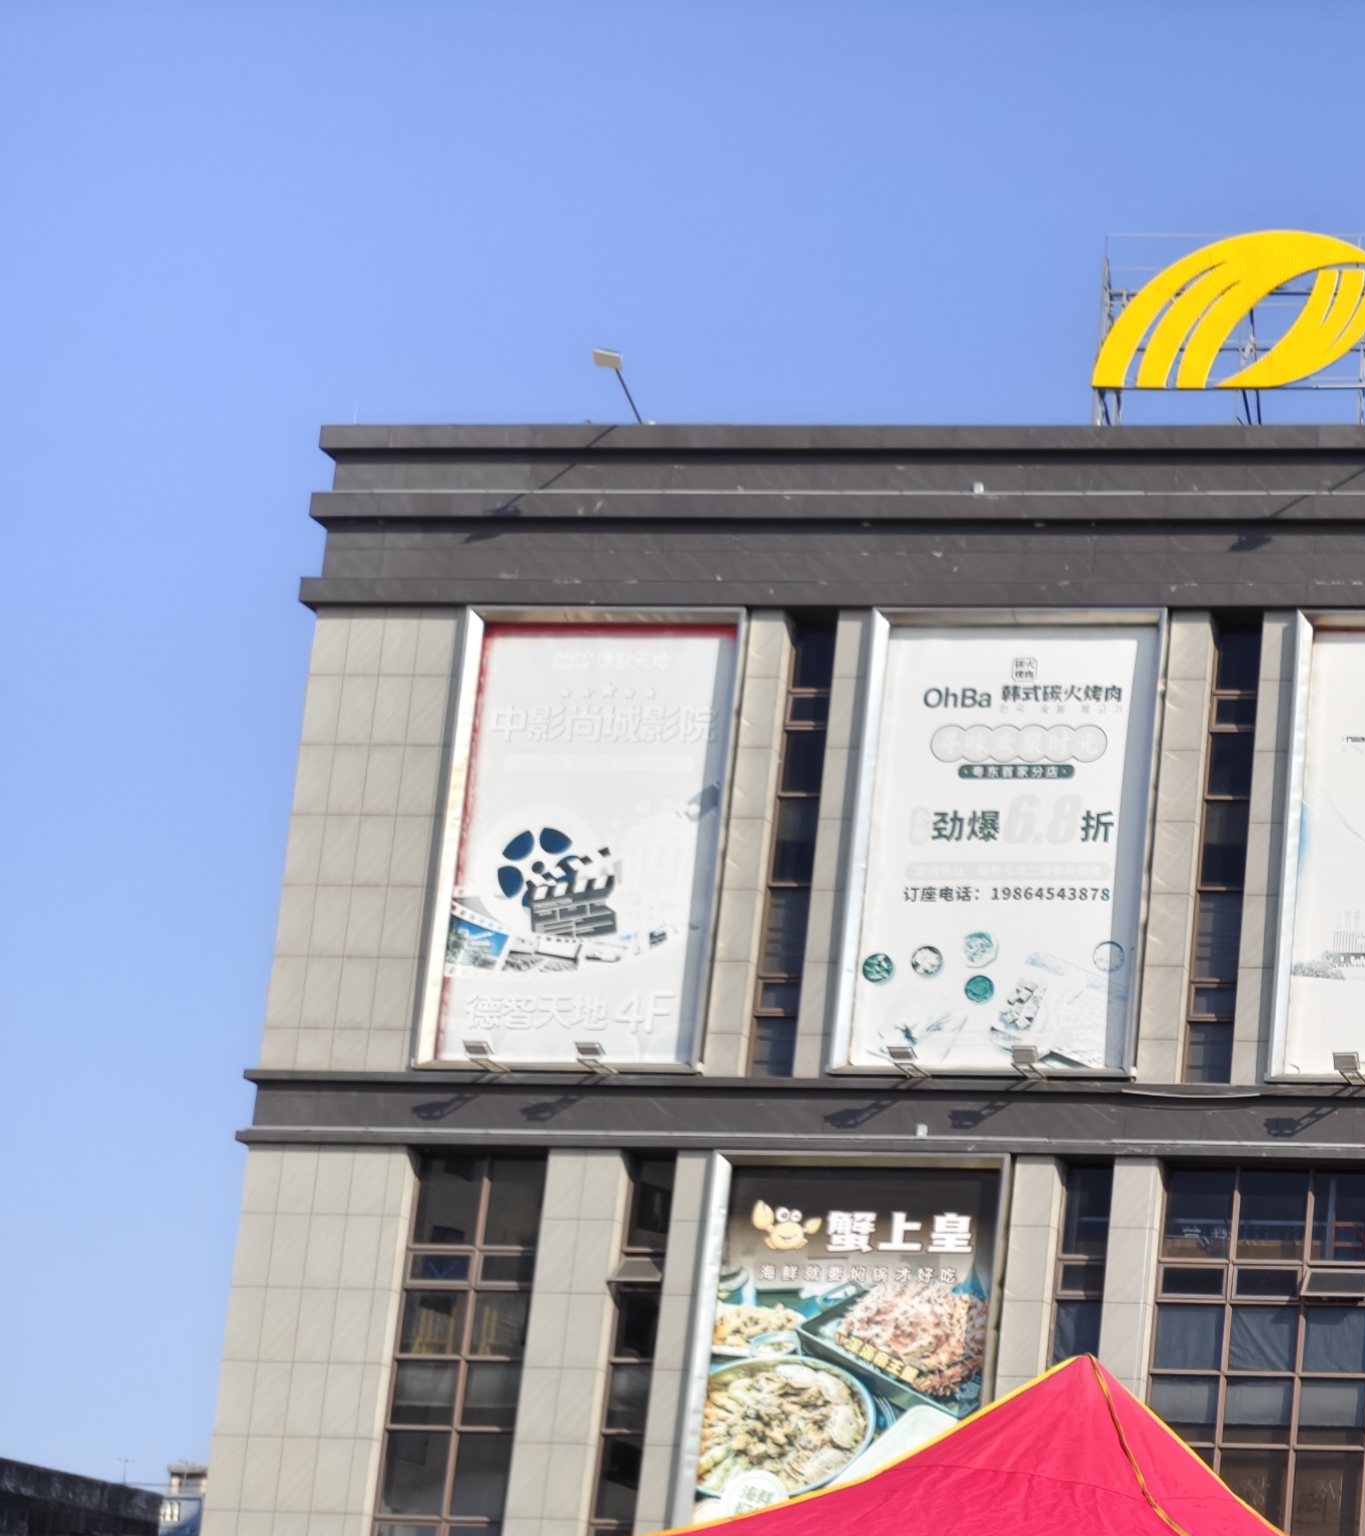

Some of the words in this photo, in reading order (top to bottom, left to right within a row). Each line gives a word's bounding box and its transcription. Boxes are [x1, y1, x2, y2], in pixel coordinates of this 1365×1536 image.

[924, 686, 992, 709] OhBa
[1001, 684, 1123, 703] 韩式碳火烤肉
[491, 703, 720, 744] 中影尚城影院
[465, 992, 609, 1032] 德智天地
[826, 1211, 973, 1254] 蟹上皇
